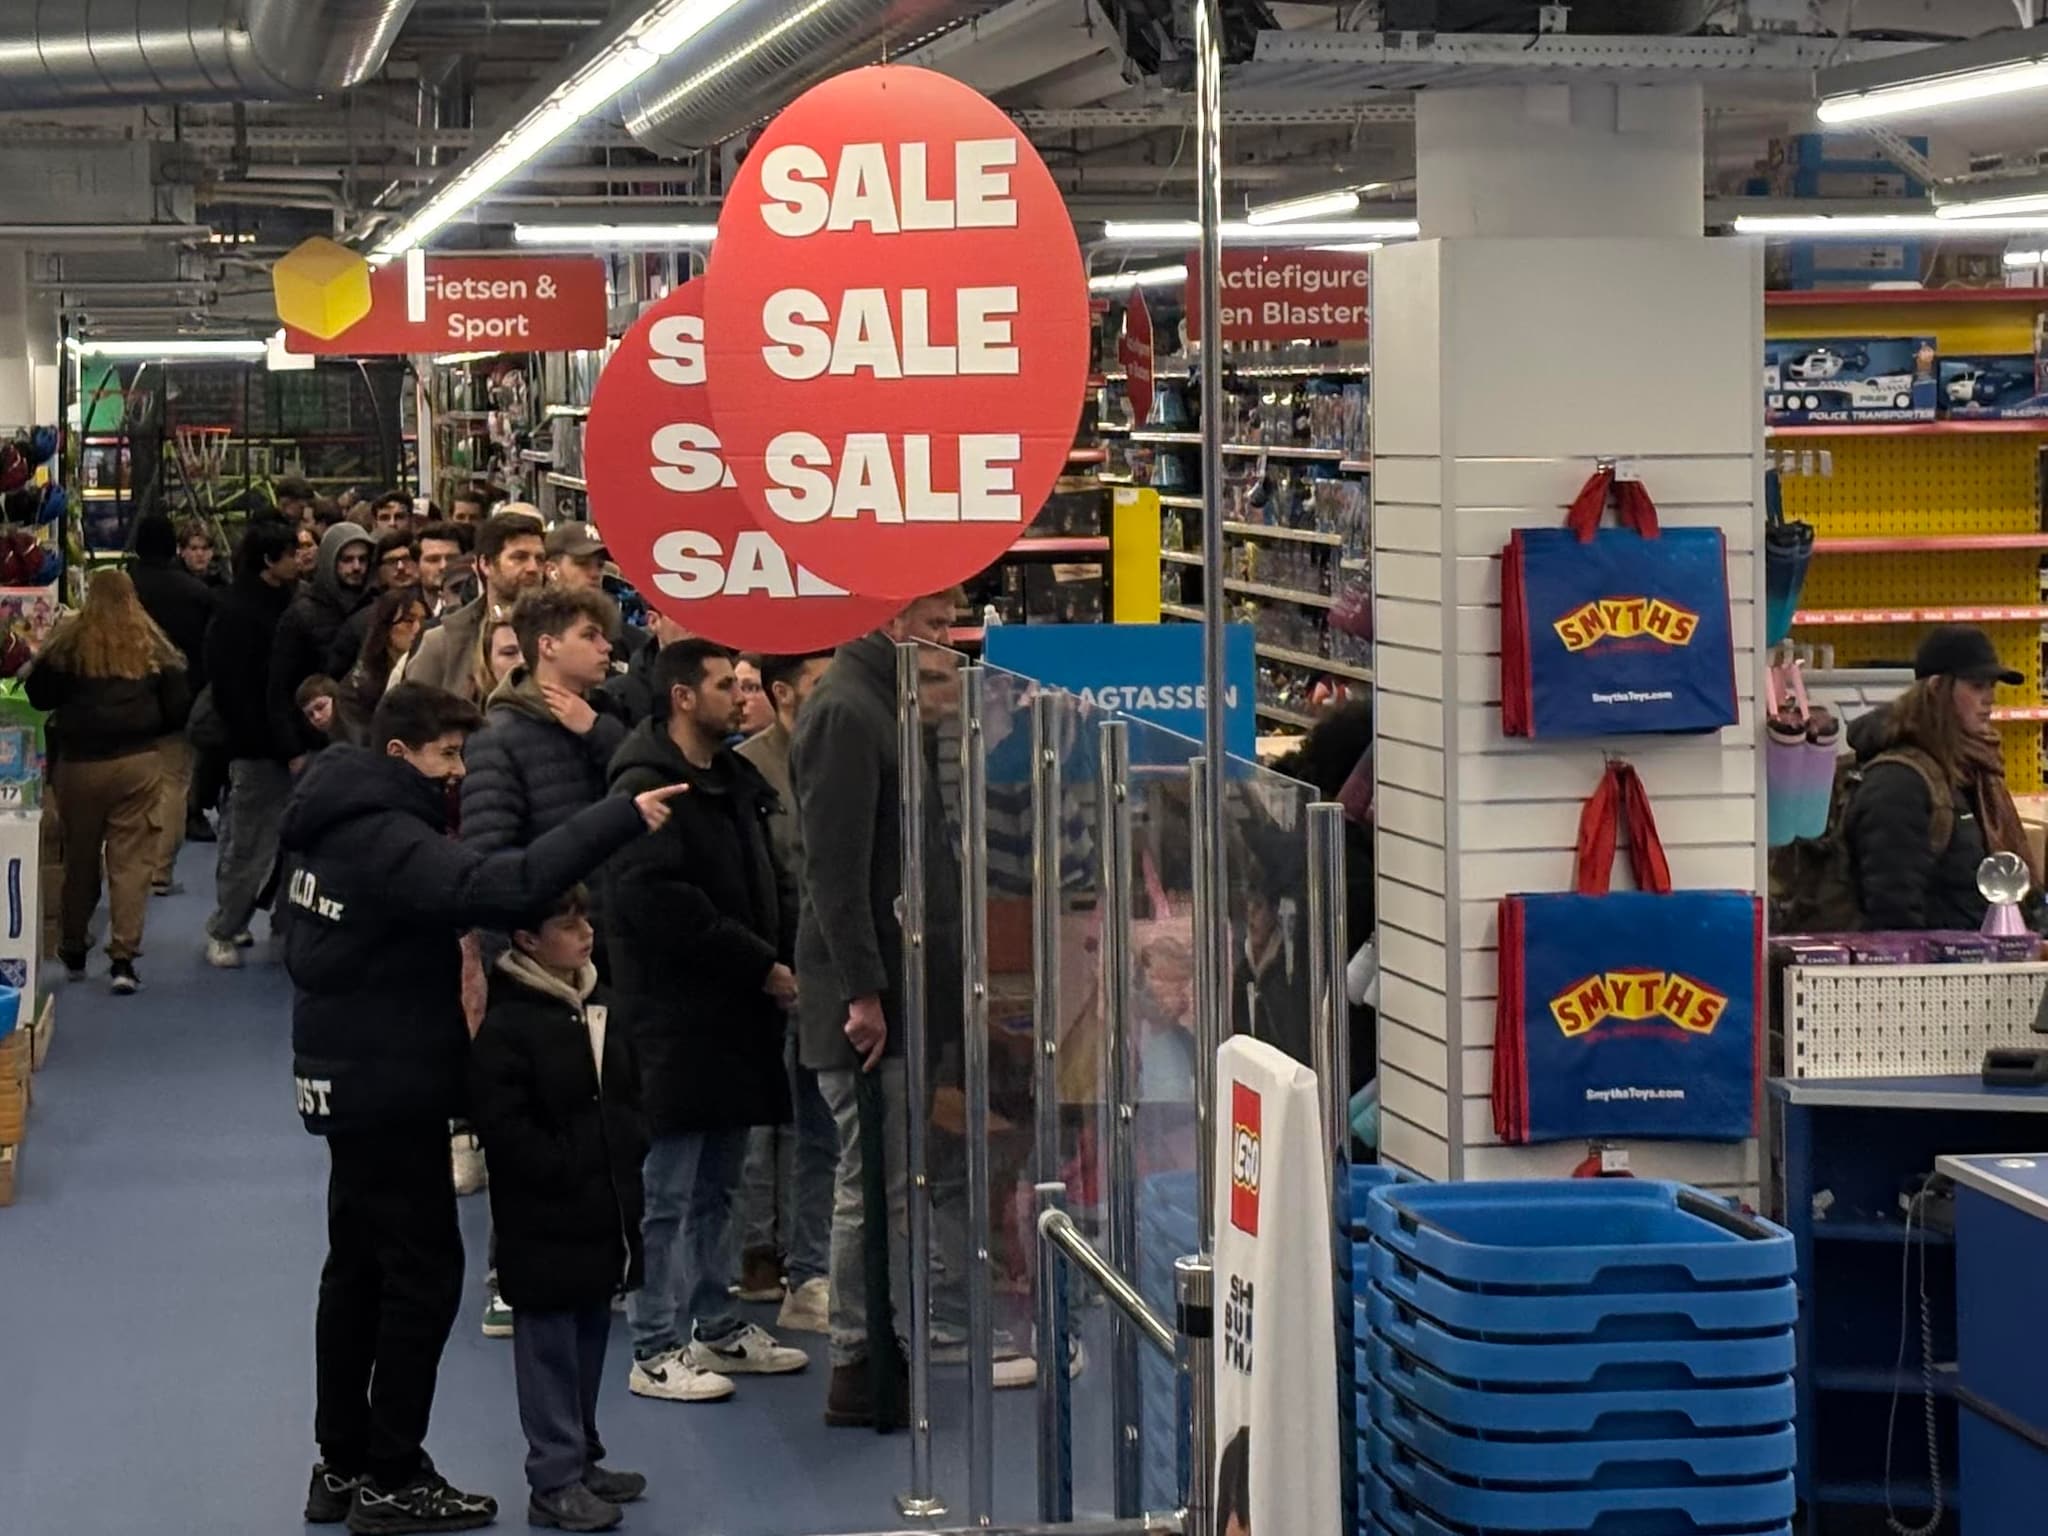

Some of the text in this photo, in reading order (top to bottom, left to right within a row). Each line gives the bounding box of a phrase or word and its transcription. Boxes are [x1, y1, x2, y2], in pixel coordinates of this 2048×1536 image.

[759, 138, 1018, 236] SALE
[535, 274, 558, 299] &
[447, 312, 530, 342] Sport
[761, 285, 1019, 380] SALE
[763, 432, 1022, 523] SALE
[651, 530, 851, 599] SA
[1559, 602, 1694, 648] SMYTHS
[1060, 685, 1237, 710] AGTASSEN
[1556, 978, 1721, 1031] SMYTHS
